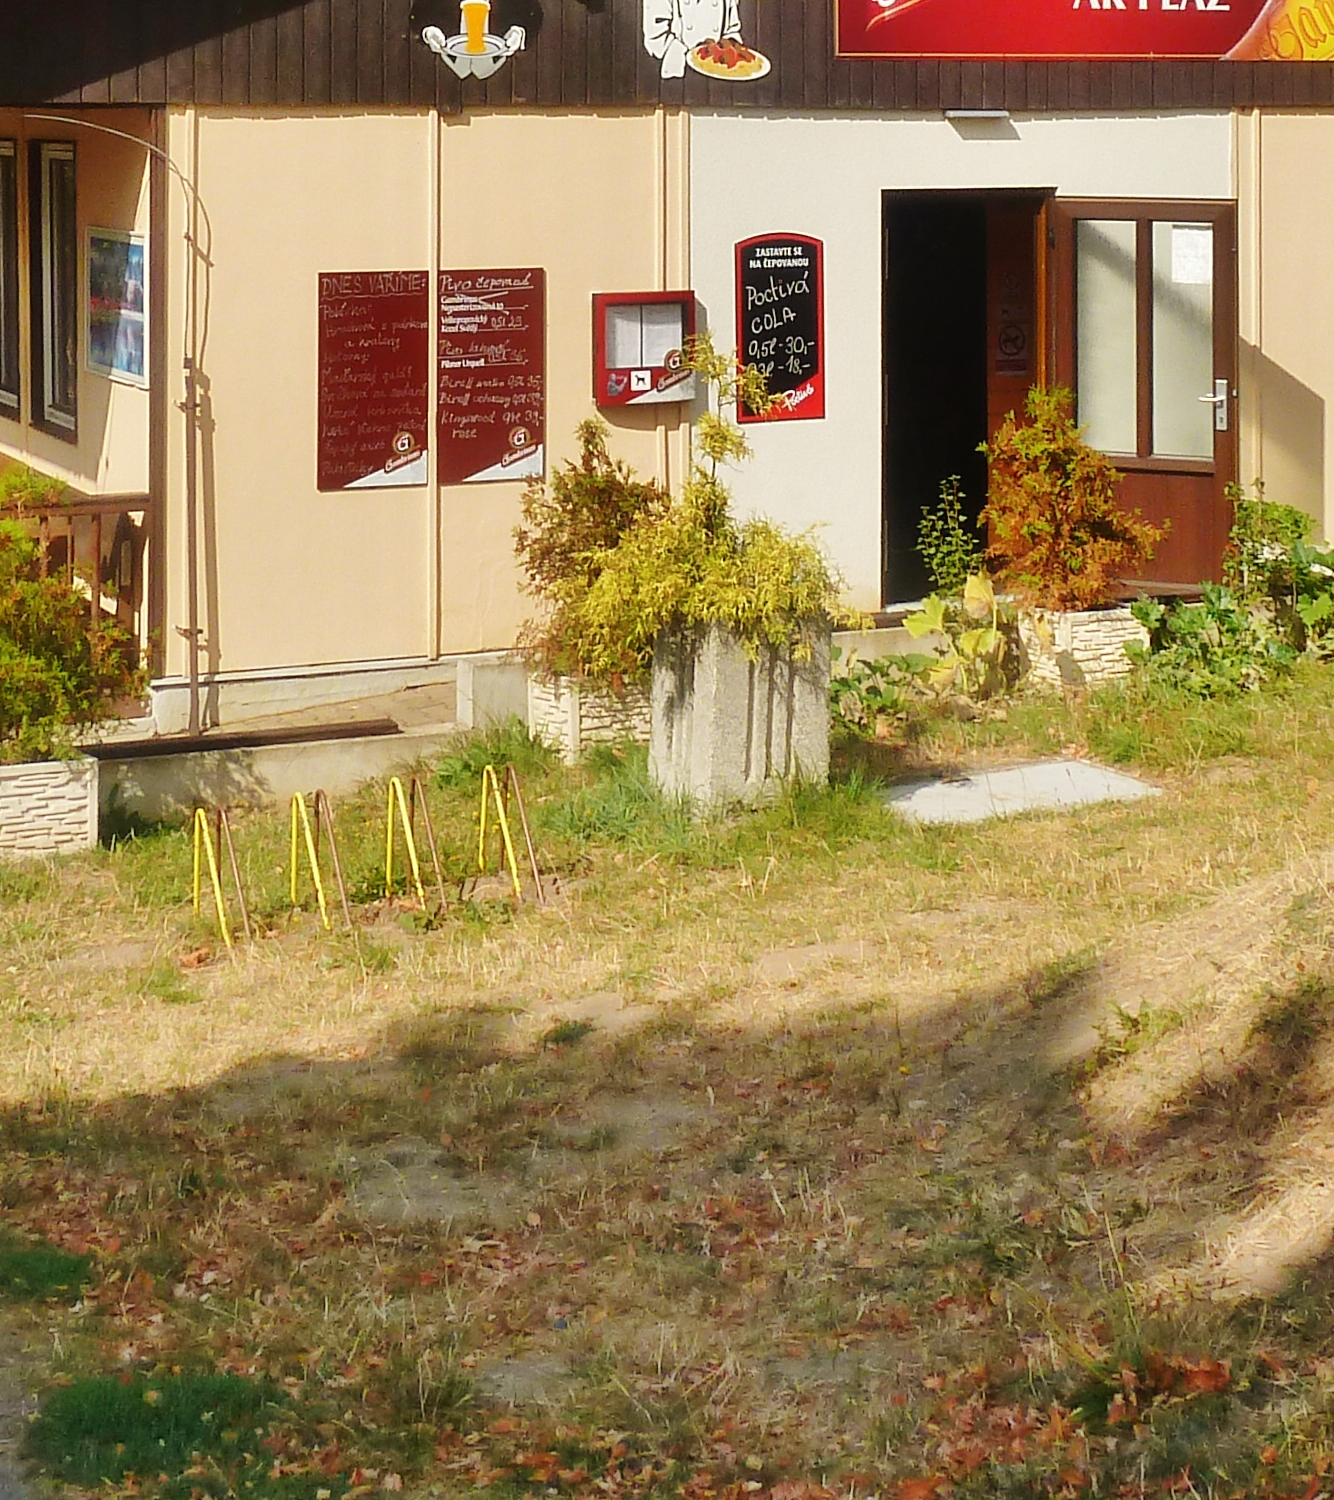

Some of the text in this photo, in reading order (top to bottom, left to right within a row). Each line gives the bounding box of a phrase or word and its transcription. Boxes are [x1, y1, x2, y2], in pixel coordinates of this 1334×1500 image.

[755, 246, 803, 257] ZASTAVTE SE
[749, 257, 809, 269] NA ČEPOVANOU
[322, 274, 362, 295] DNES
[439, 274, 471, 293] Pivo
[745, 270, 810, 311] Poctivá
[751, 307, 797, 334] COLA
